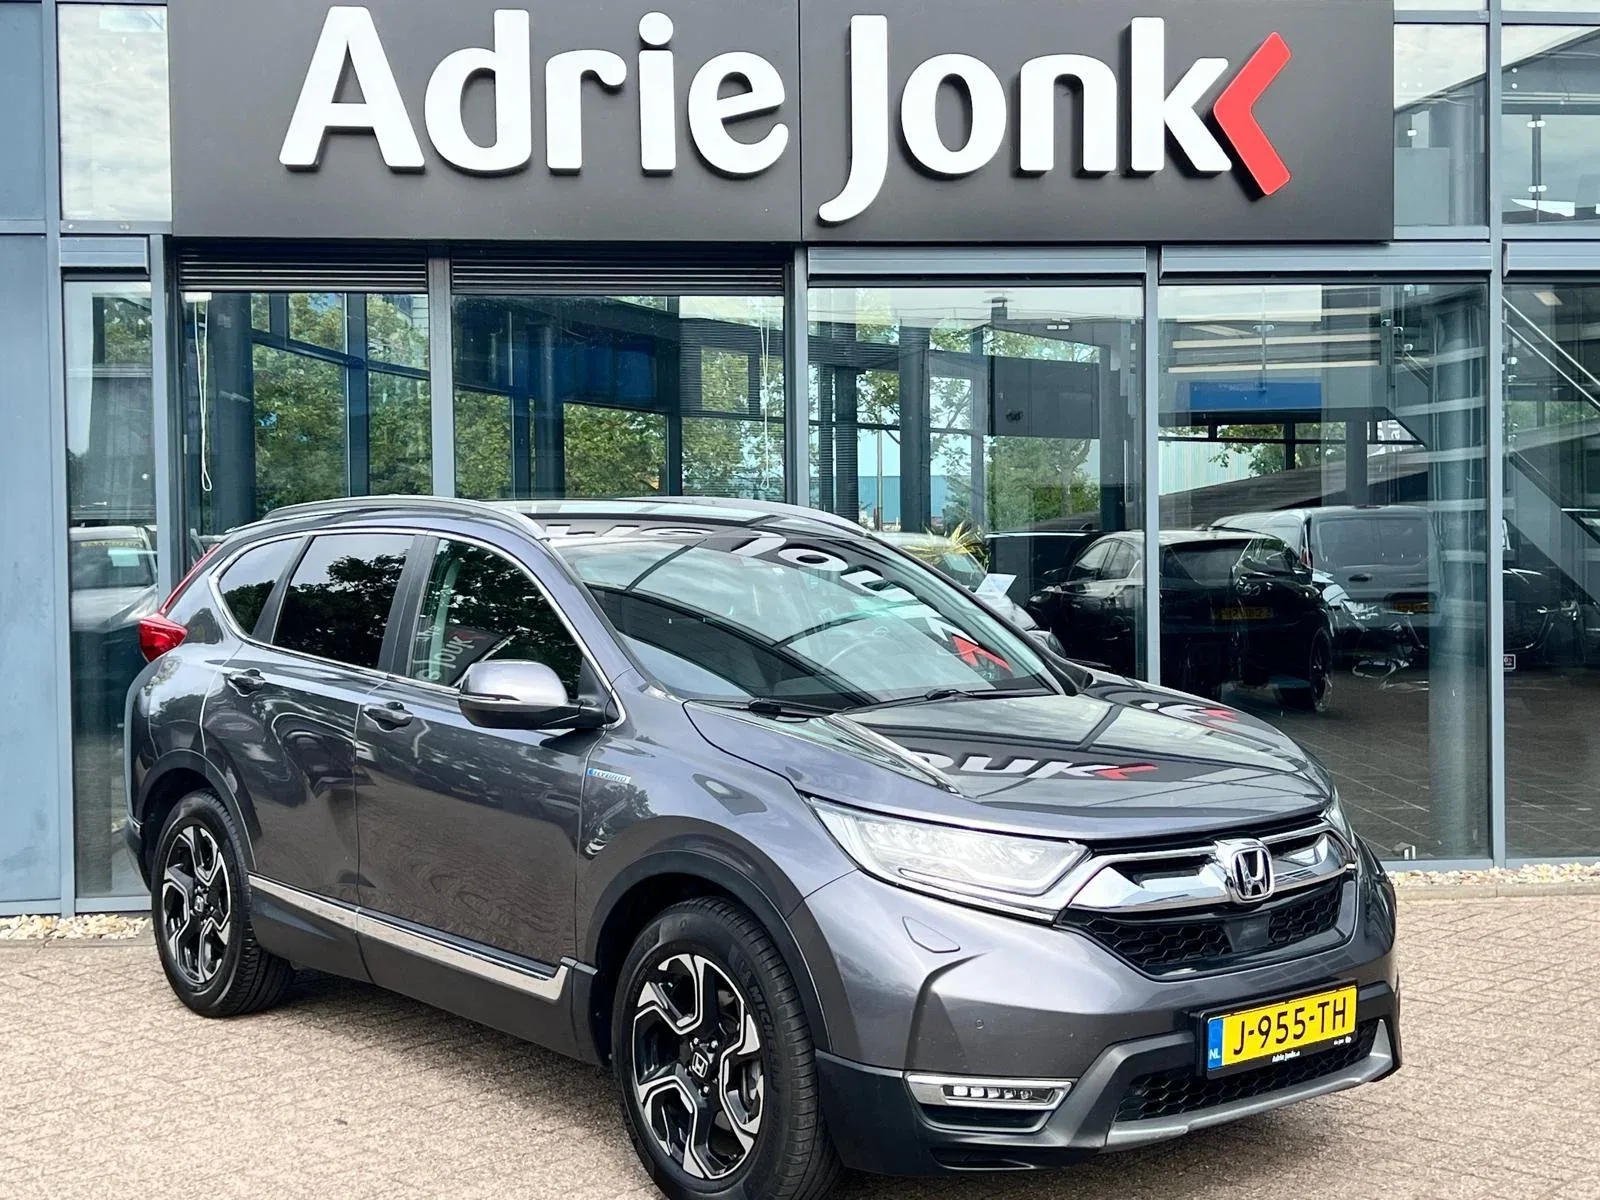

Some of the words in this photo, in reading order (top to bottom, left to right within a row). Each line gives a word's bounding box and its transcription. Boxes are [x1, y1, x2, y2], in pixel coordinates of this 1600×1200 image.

[278, 5, 789, 176] Adrie
[818, 14, 1232, 224] Jonk
[1209, 1049, 1221, 1060] NL
[1233, 997, 1347, 1056] J-955-TH
